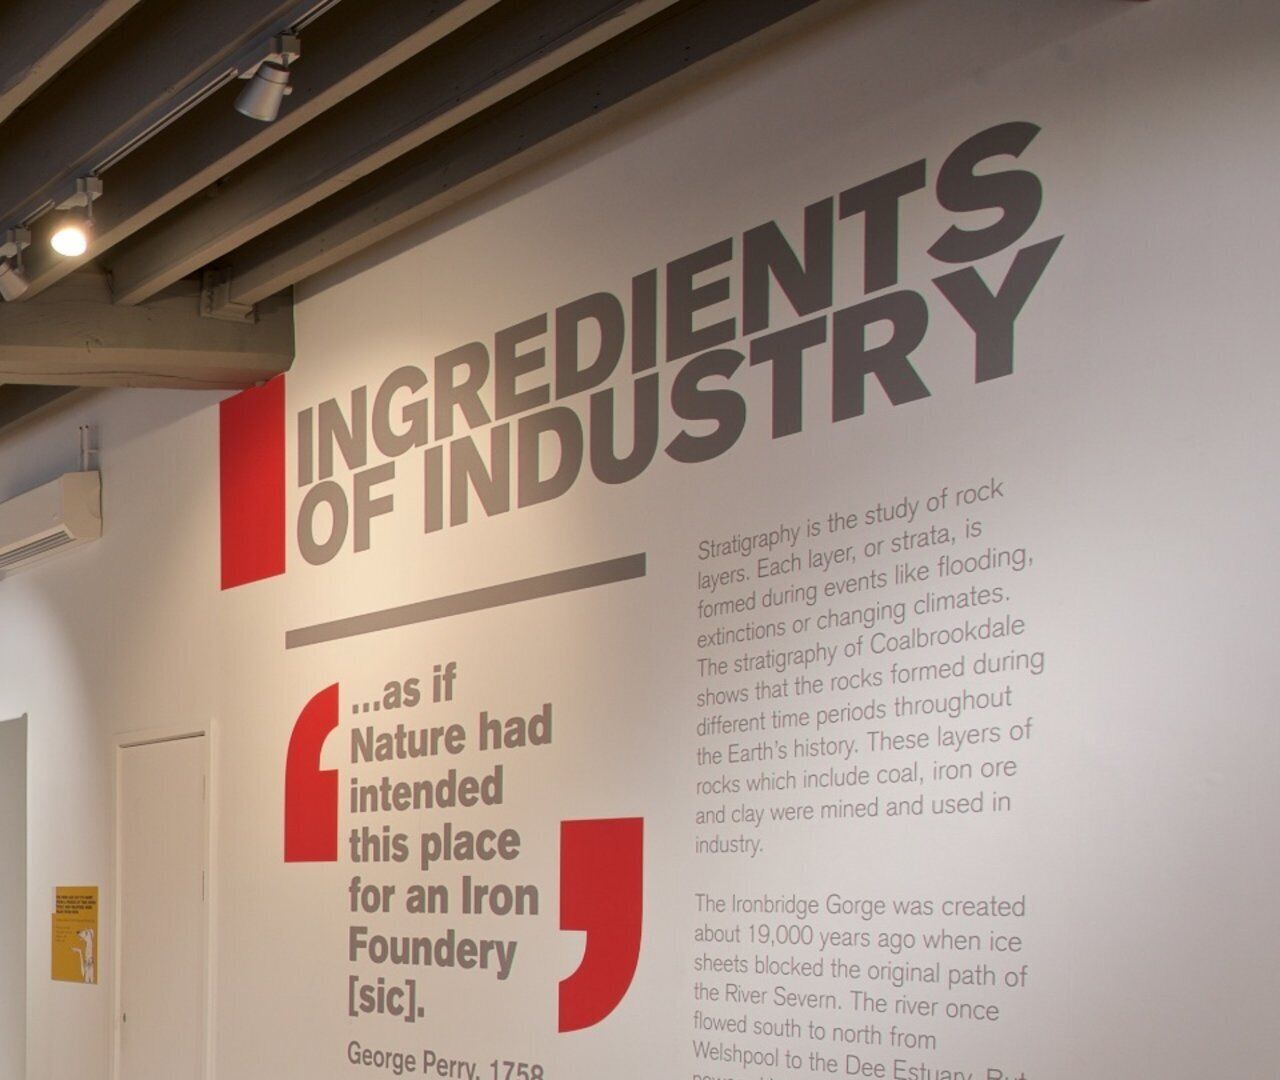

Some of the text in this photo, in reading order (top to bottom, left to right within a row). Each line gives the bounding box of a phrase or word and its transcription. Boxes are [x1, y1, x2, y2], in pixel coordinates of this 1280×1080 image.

[298, 121, 1042, 487] INGREDIENTS
[297, 235, 1065, 567] OF INDUSTRY
[698, 477, 1003, 560] Stratigraphy is the study of rock
[698, 518, 982, 590] layers. Each layer, or strata, is
[698, 548, 1032, 618] formed during events like flooding,
[697, 586, 1010, 648] extinctions or changing climates.
[697, 614, 1025, 677] The stratigraphy of Coalbrookdale
[352, 662, 457, 714] ...as if
[697, 652, 1044, 707] shows that the rocks formed during
[351, 703, 553, 763] Nature had
[697, 685, 1012, 736] different time periods throughout
[697, 717, 1032, 766] the Earth's history. These layers of
[351, 765, 504, 813] intended
[697, 760, 1017, 795] rocks which include coal, iron ore
[696, 791, 1010, 828] and clay were mined and used in
[349, 823, 521, 870] this place
[696, 834, 763, 858] industry.
[349, 875, 539, 916] for an Iron
[695, 893, 1025, 921] The Ironbridge Gorge was created
[349, 926, 517, 980] Foundery
[695, 923, 1022, 955] about 19,000 years ago when ice
[694, 952, 1028, 990] sheets blocked the original path of
[348, 975, 425, 1023] [sic].
[347, 1041, 416, 1075] George
